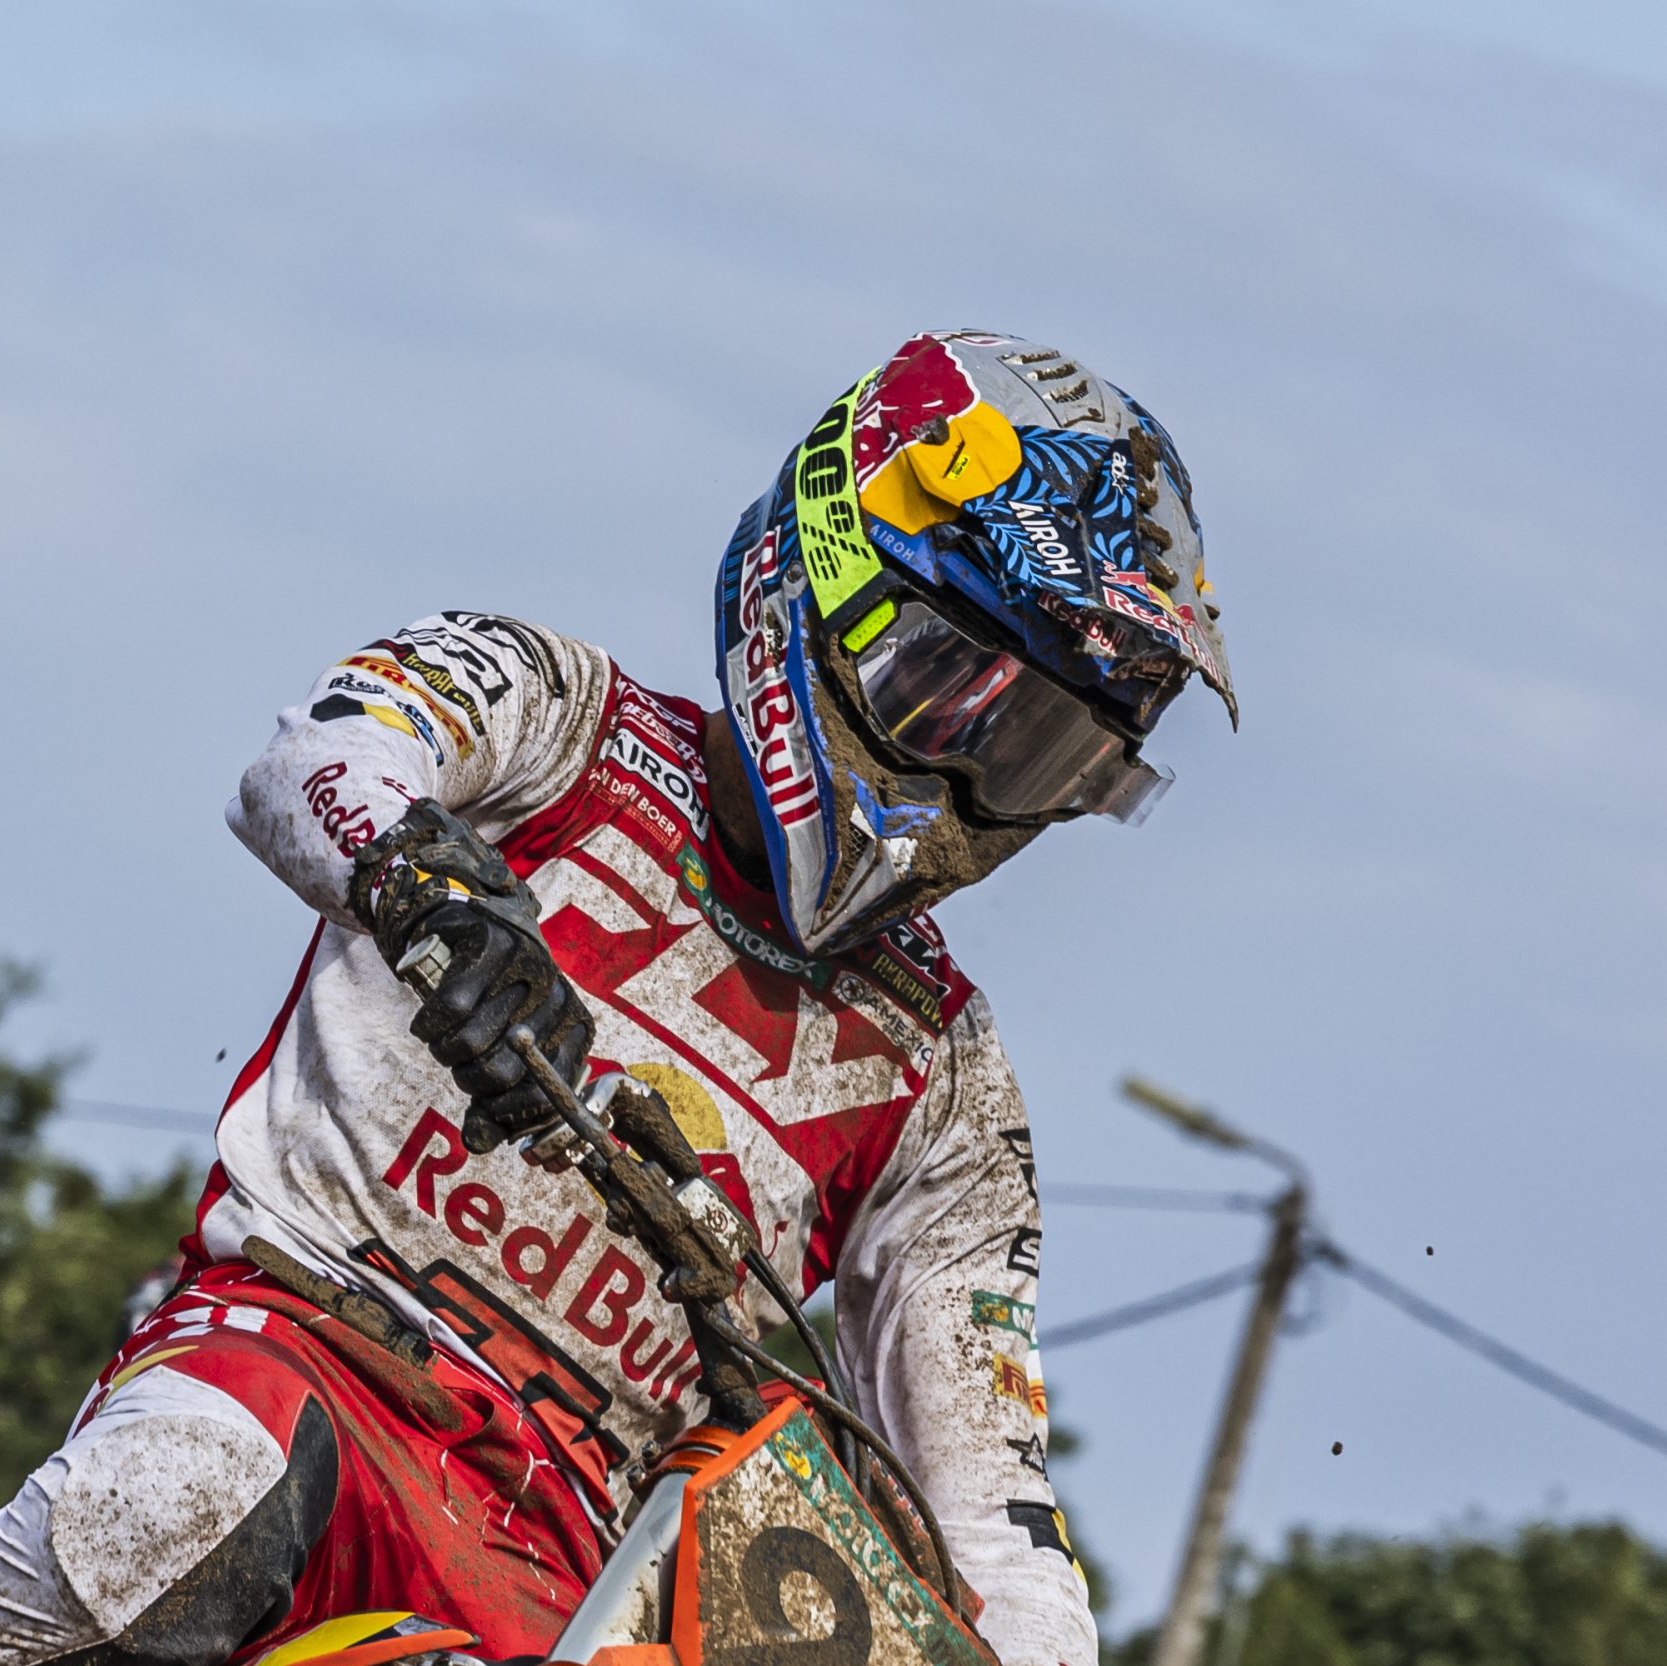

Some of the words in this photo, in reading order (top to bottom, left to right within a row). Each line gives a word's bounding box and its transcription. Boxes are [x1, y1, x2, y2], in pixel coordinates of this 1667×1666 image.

[870, 523, 916, 563] AIROH
[1007, 499, 1084, 576] AIROH
[1103, 584, 1178, 643] Red
[614, 732, 710, 828] AIROH
[748, 678, 821, 826] Bull
[610, 775, 644, 804] DEN
[638, 796, 679, 838] BOER
[381, 1105, 594, 1301] Red
[562, 1244, 703, 1406] Bull
